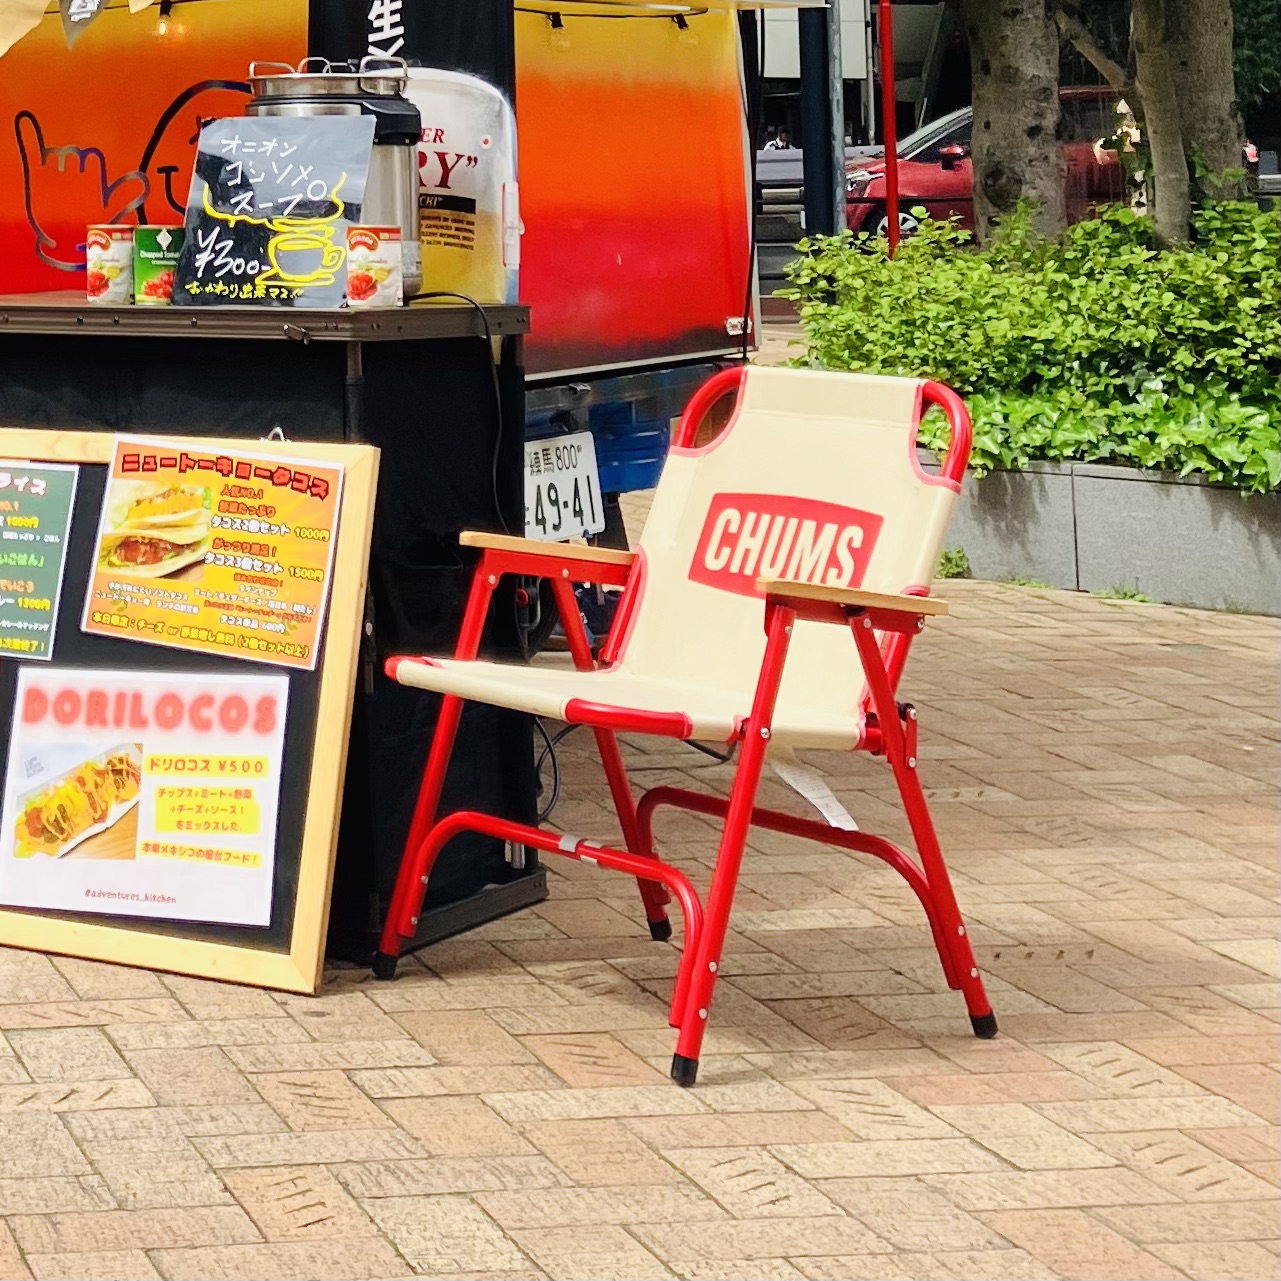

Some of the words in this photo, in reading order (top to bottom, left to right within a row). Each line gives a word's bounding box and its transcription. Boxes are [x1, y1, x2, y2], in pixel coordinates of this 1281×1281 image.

[221, 134, 297, 157] オニオン
[226, 161, 313, 187] コンソメ
[230, 179, 328, 216] スープ
[555, 444, 578, 470] 800
[122, 453, 329, 500] ニュートーキョータコス
[535, 475, 596, 535] 49-41
[211, 514, 291, 536] タコス2個セット
[294, 527, 330, 542] 1000円
[704, 507, 864, 587] CHUMS
[204, 551, 284, 575] タコス3個セット
[288, 566, 324, 582] 1500円
[22, 687, 277, 734] DORILOCOS
[150, 759, 211, 772] ドリロコス
[85, 889, 177, 904] #adventures_kitchen
